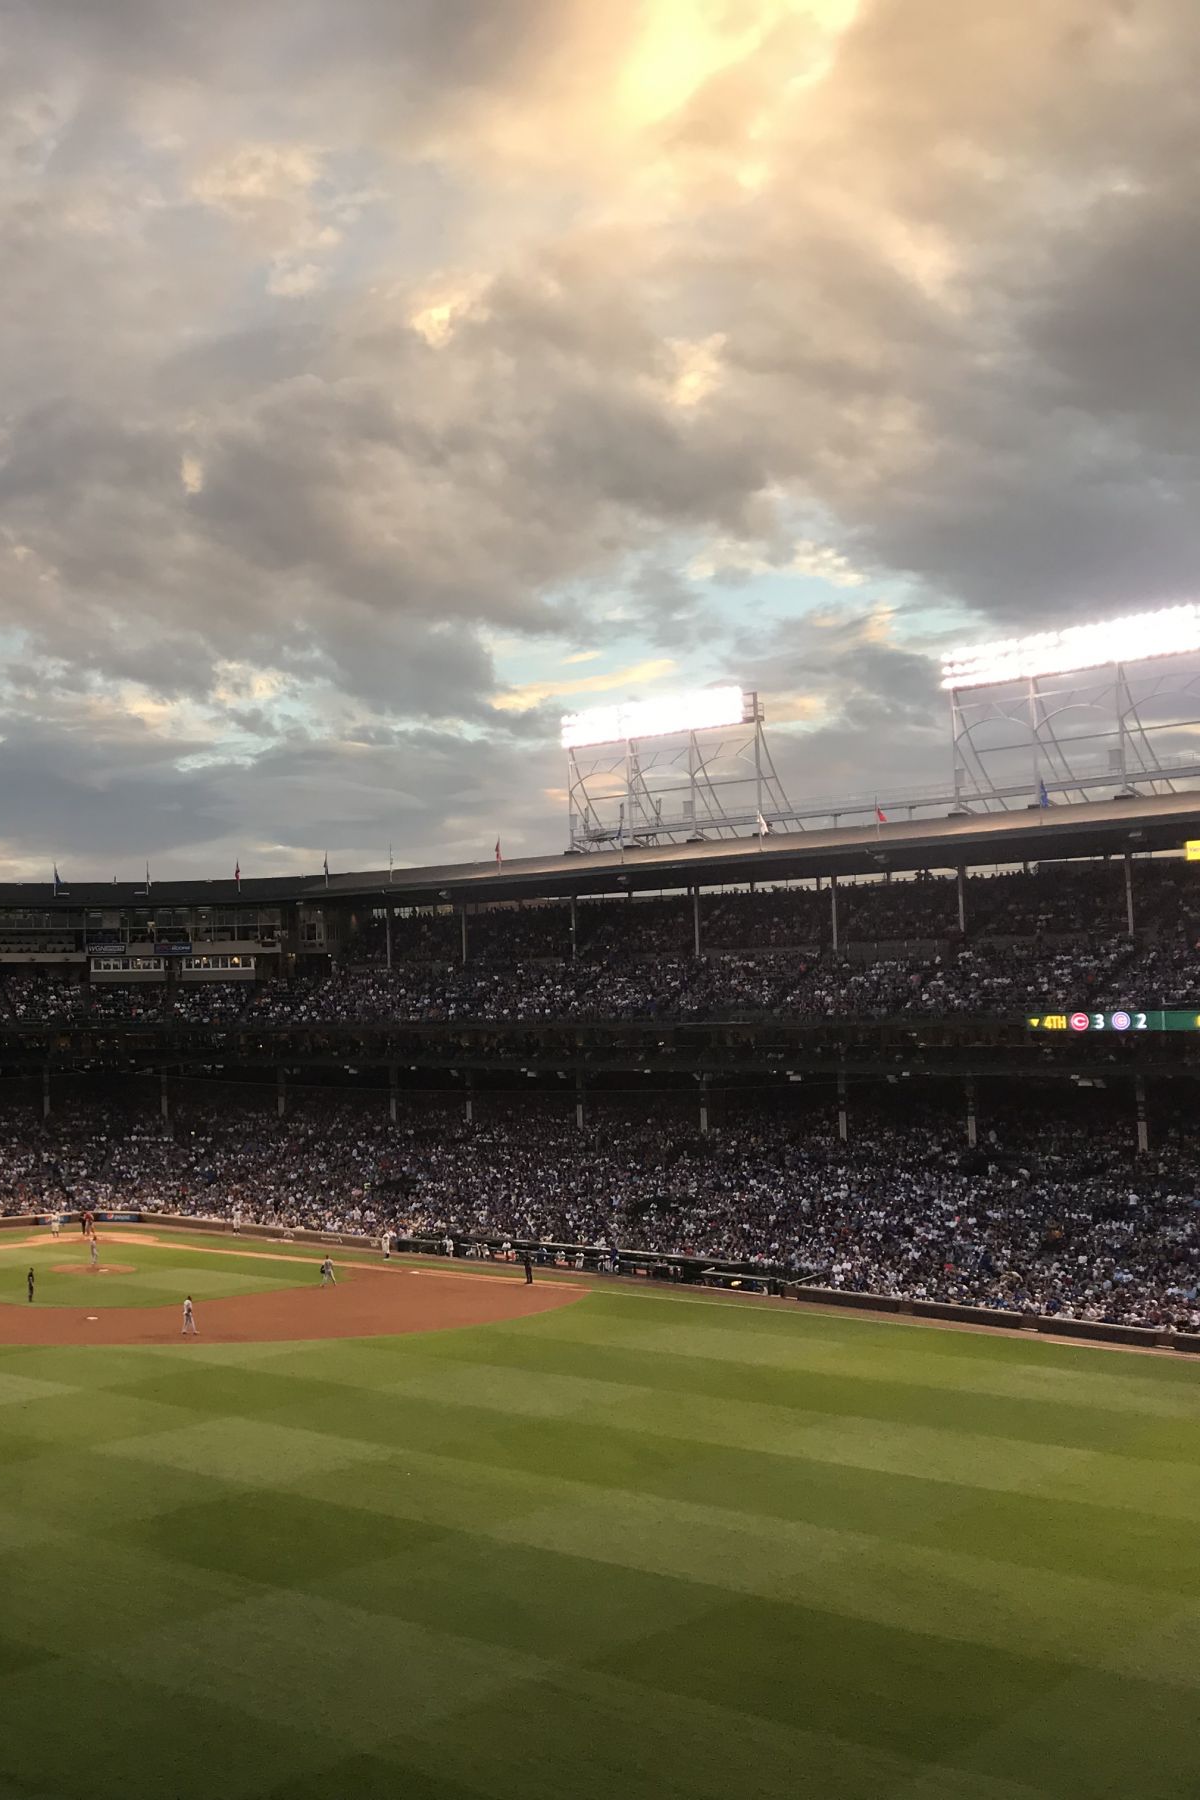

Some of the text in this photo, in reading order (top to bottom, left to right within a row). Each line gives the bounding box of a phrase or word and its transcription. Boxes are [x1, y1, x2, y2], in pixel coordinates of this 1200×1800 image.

[1043, 1015, 1067, 1029] 4TH
[1095, 1013, 1105, 1029] 3
[1136, 1013, 1147, 1029] 2
